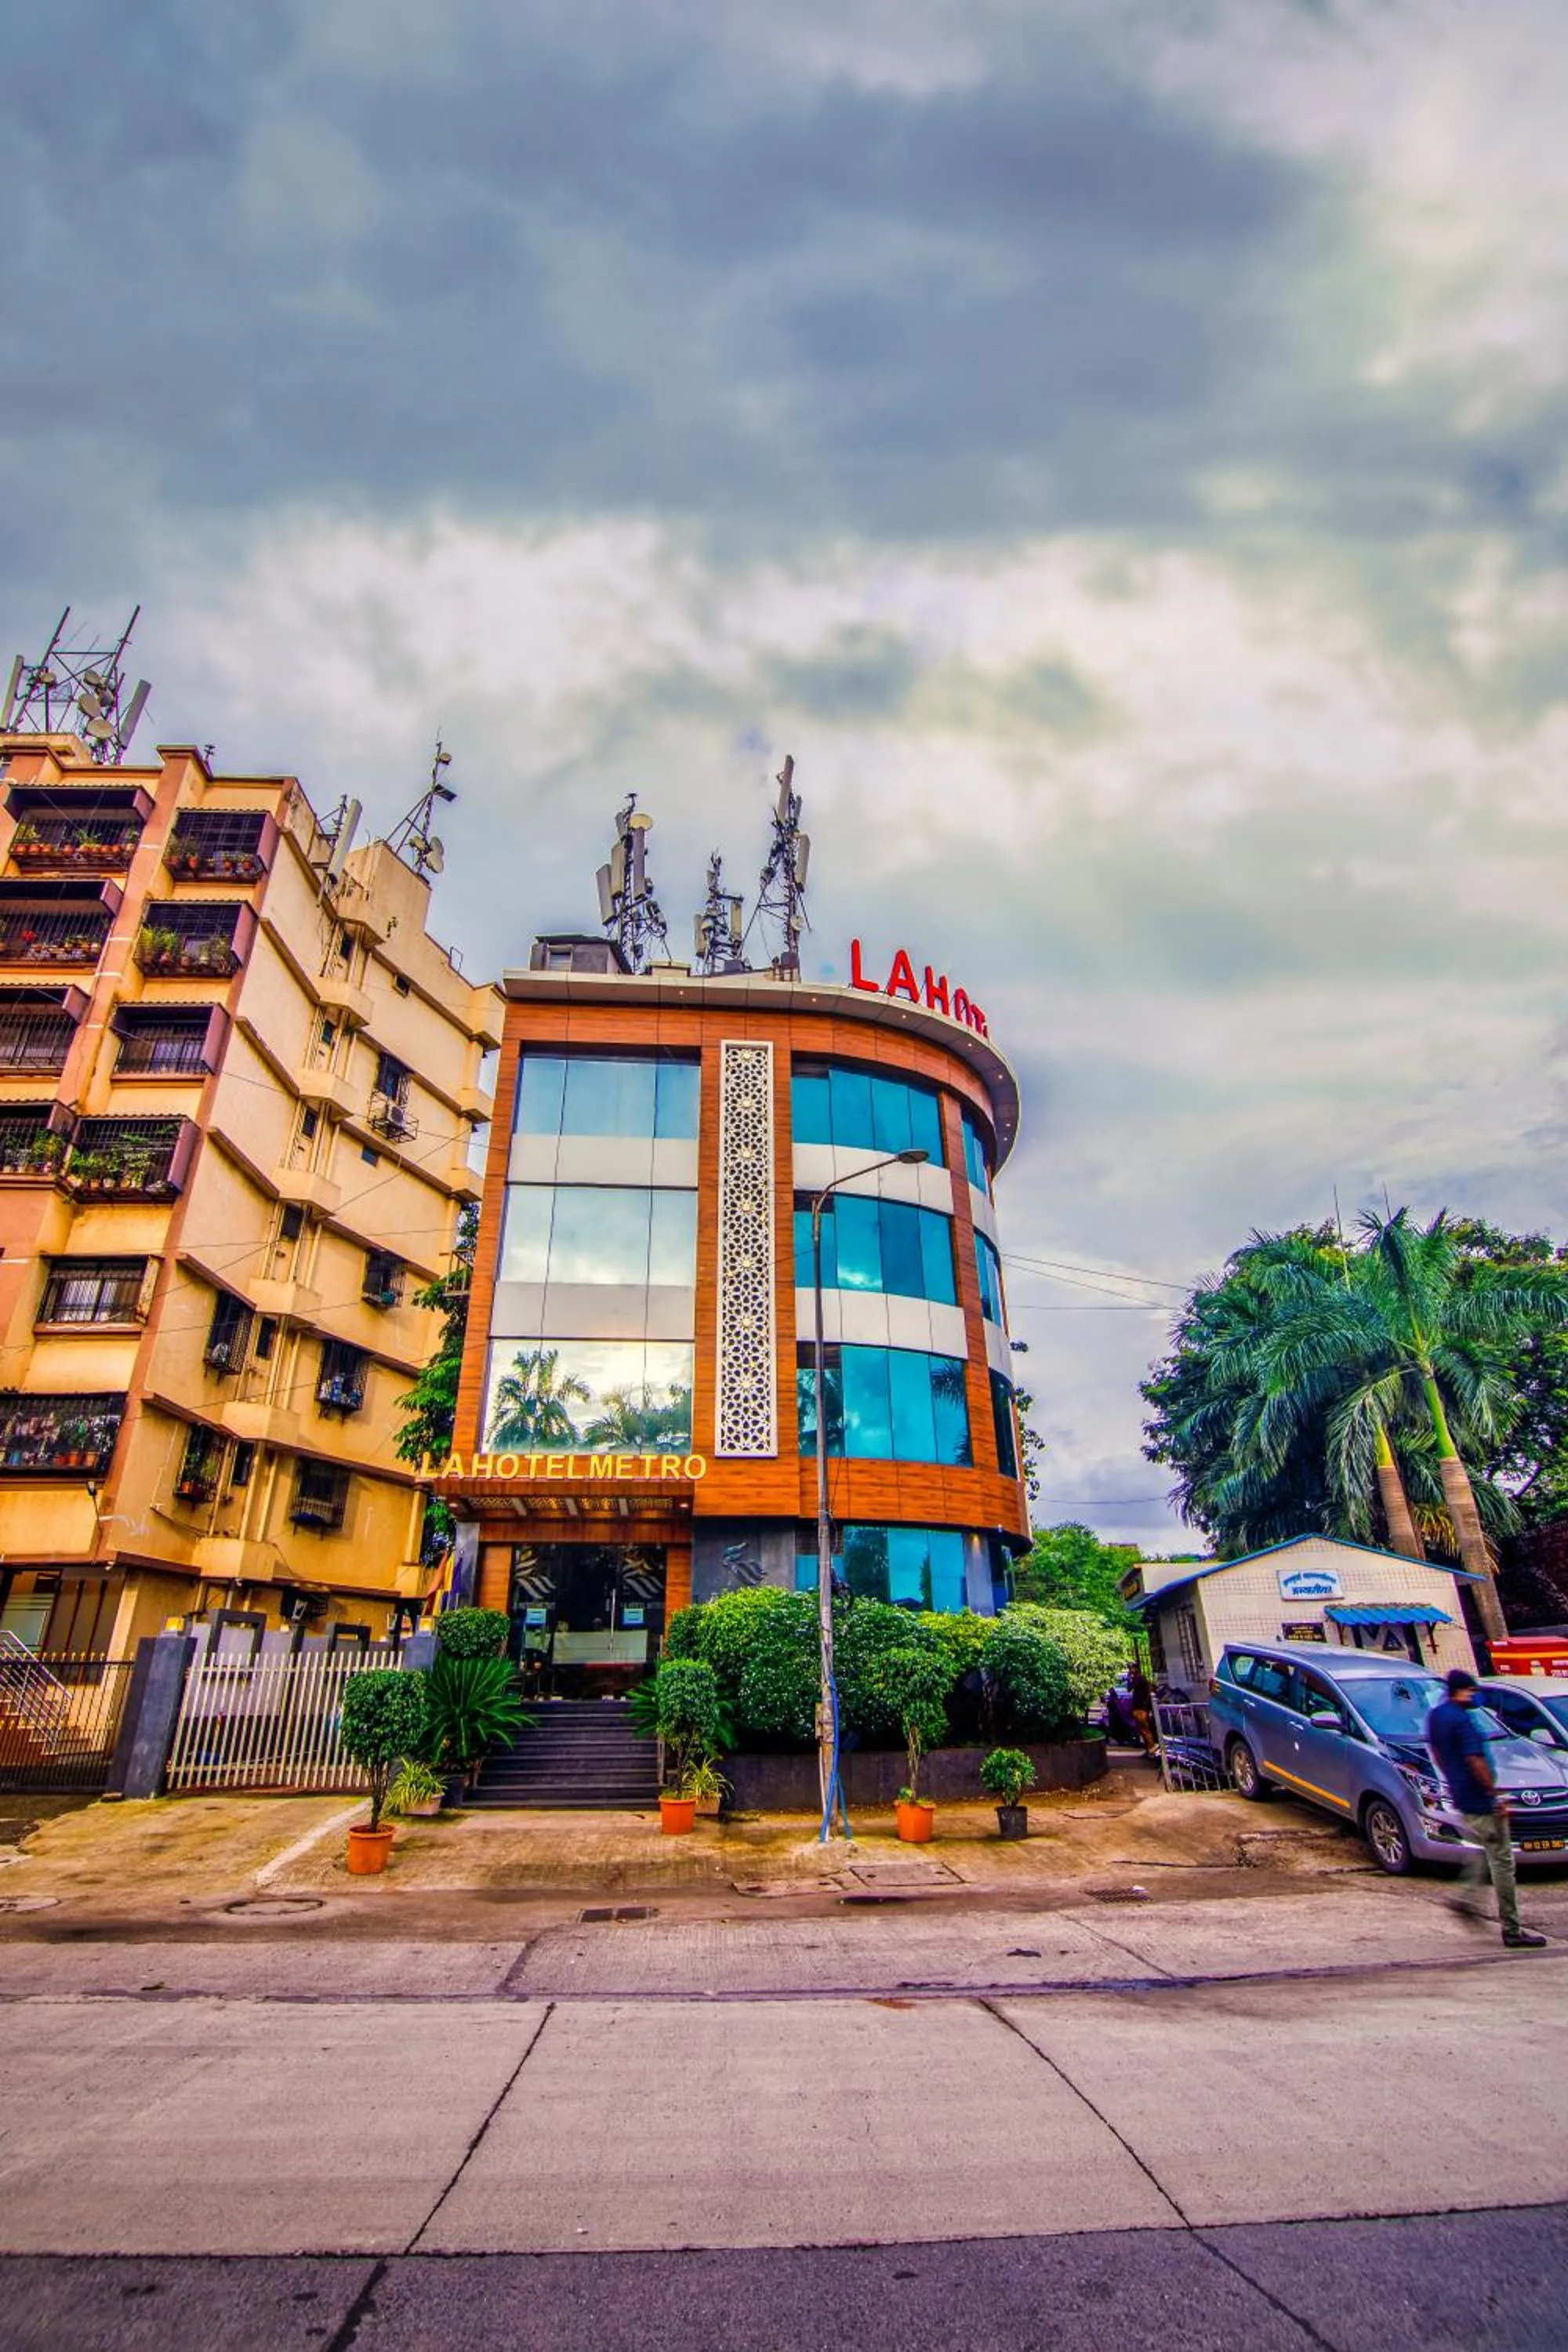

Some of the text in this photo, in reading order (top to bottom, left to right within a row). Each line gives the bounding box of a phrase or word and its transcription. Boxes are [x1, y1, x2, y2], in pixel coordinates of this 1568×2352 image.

[419, 1451, 707, 1480] LA HOTEL METRO
